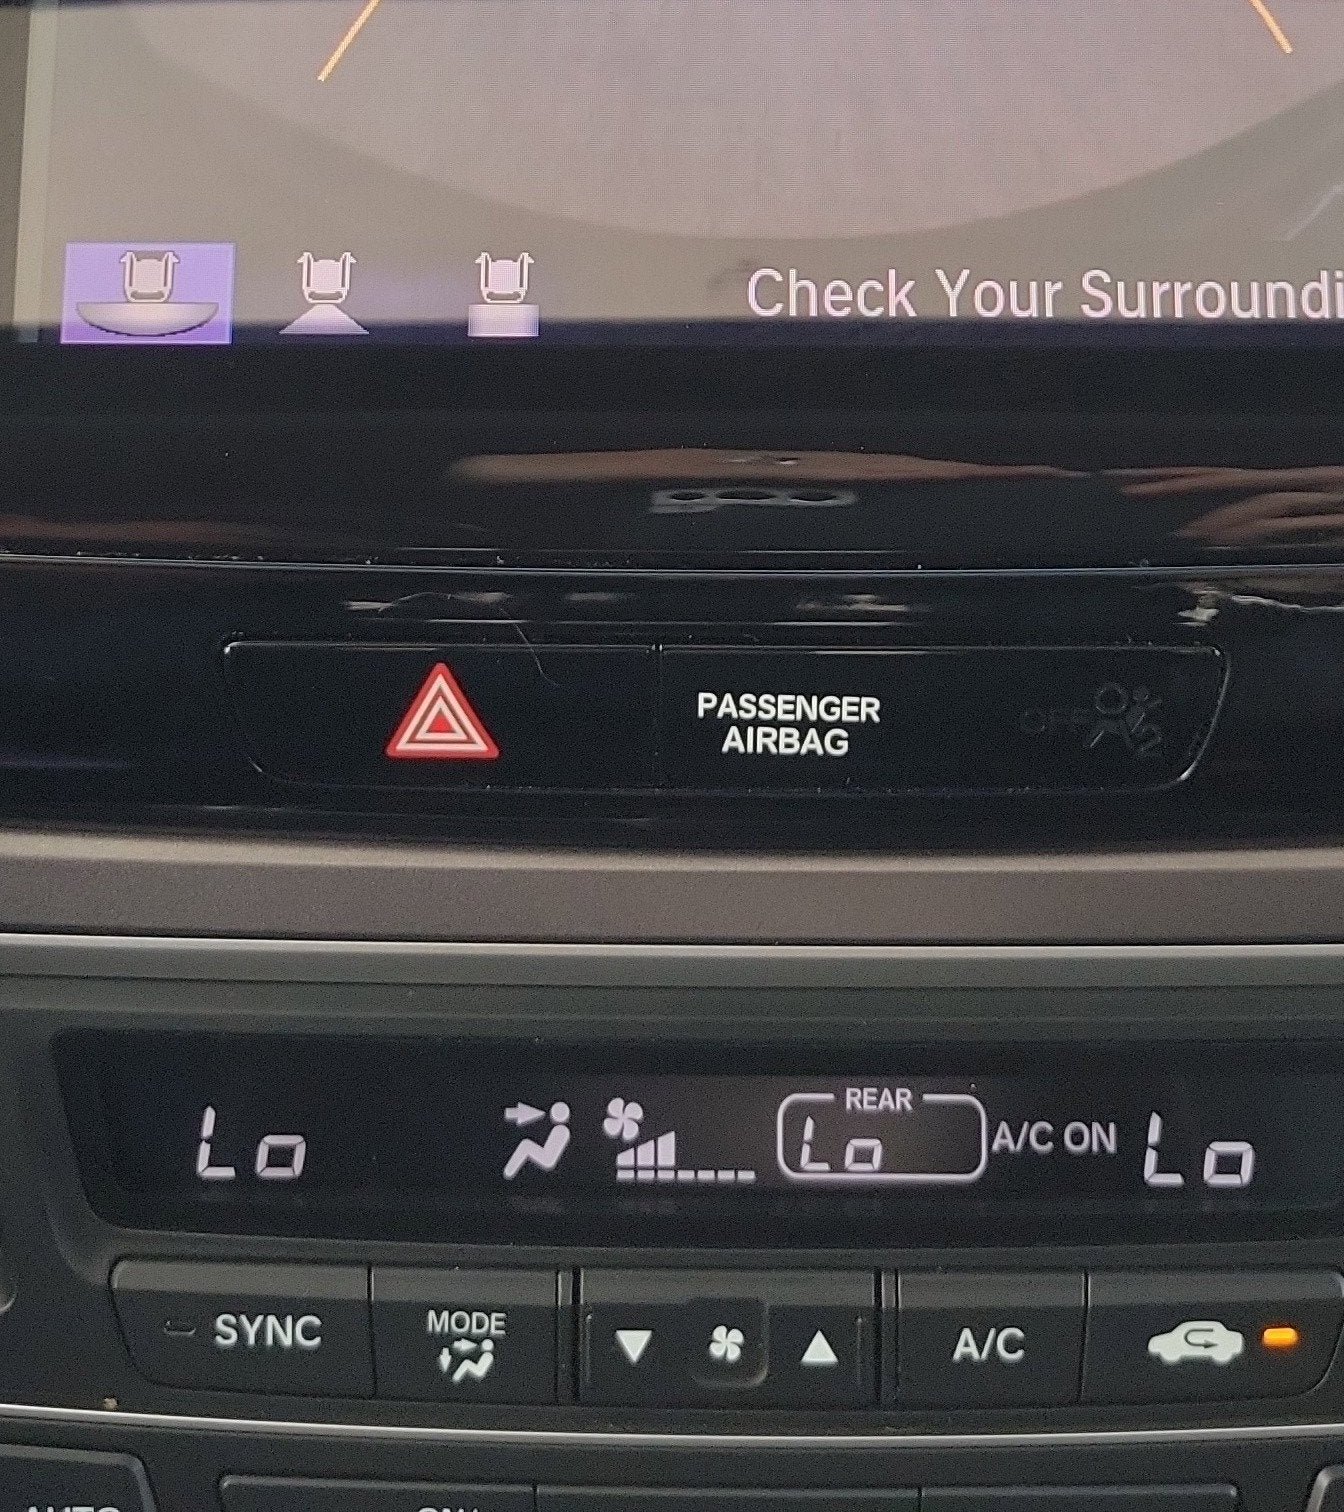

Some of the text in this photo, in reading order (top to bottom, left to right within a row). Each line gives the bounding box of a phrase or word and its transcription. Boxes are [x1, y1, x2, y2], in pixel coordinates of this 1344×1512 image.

[746, 268, 918, 318] Check
[934, 268, 1063, 318] Your
[697, 692, 881, 724] PASSENGER
[721, 725, 849, 757] AIRBAG
[845, 1088, 913, 1112] REAR
[196, 1105, 307, 1178] Lo
[799, 1114, 884, 1172] Lo
[992, 1120, 1117, 1153] A/C ON
[1143, 1111, 1256, 1186] Lo
[213, 1313, 323, 1348] SYNC
[426, 1309, 507, 1336] MODE
[951, 1326, 1026, 1362] A/C
